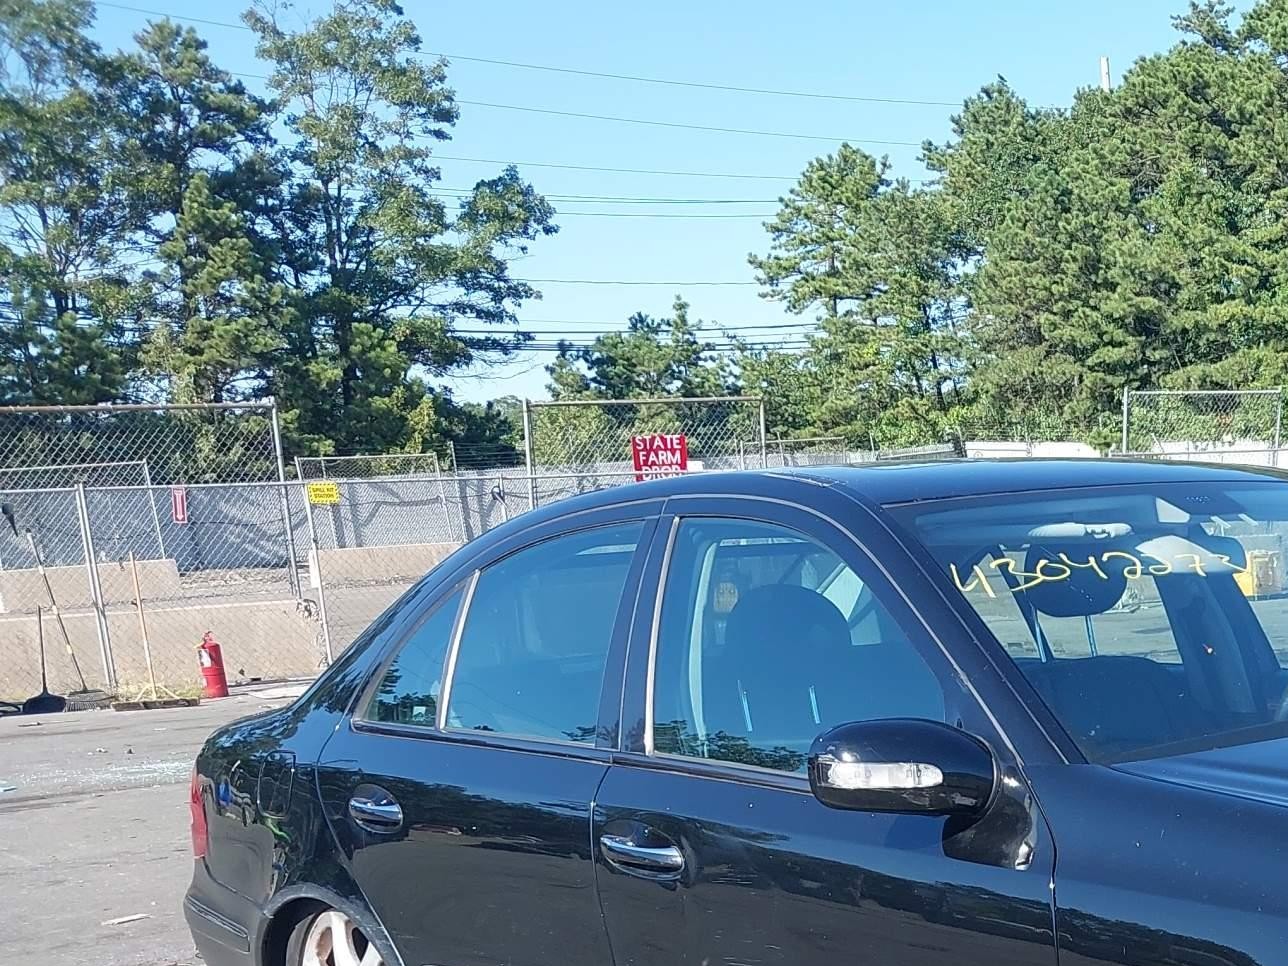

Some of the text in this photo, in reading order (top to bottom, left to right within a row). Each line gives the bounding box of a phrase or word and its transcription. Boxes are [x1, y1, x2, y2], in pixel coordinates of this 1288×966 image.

[635, 434, 682, 450] STATE
[639, 450, 682, 466] FARM
[641, 465, 681, 481] DROP
